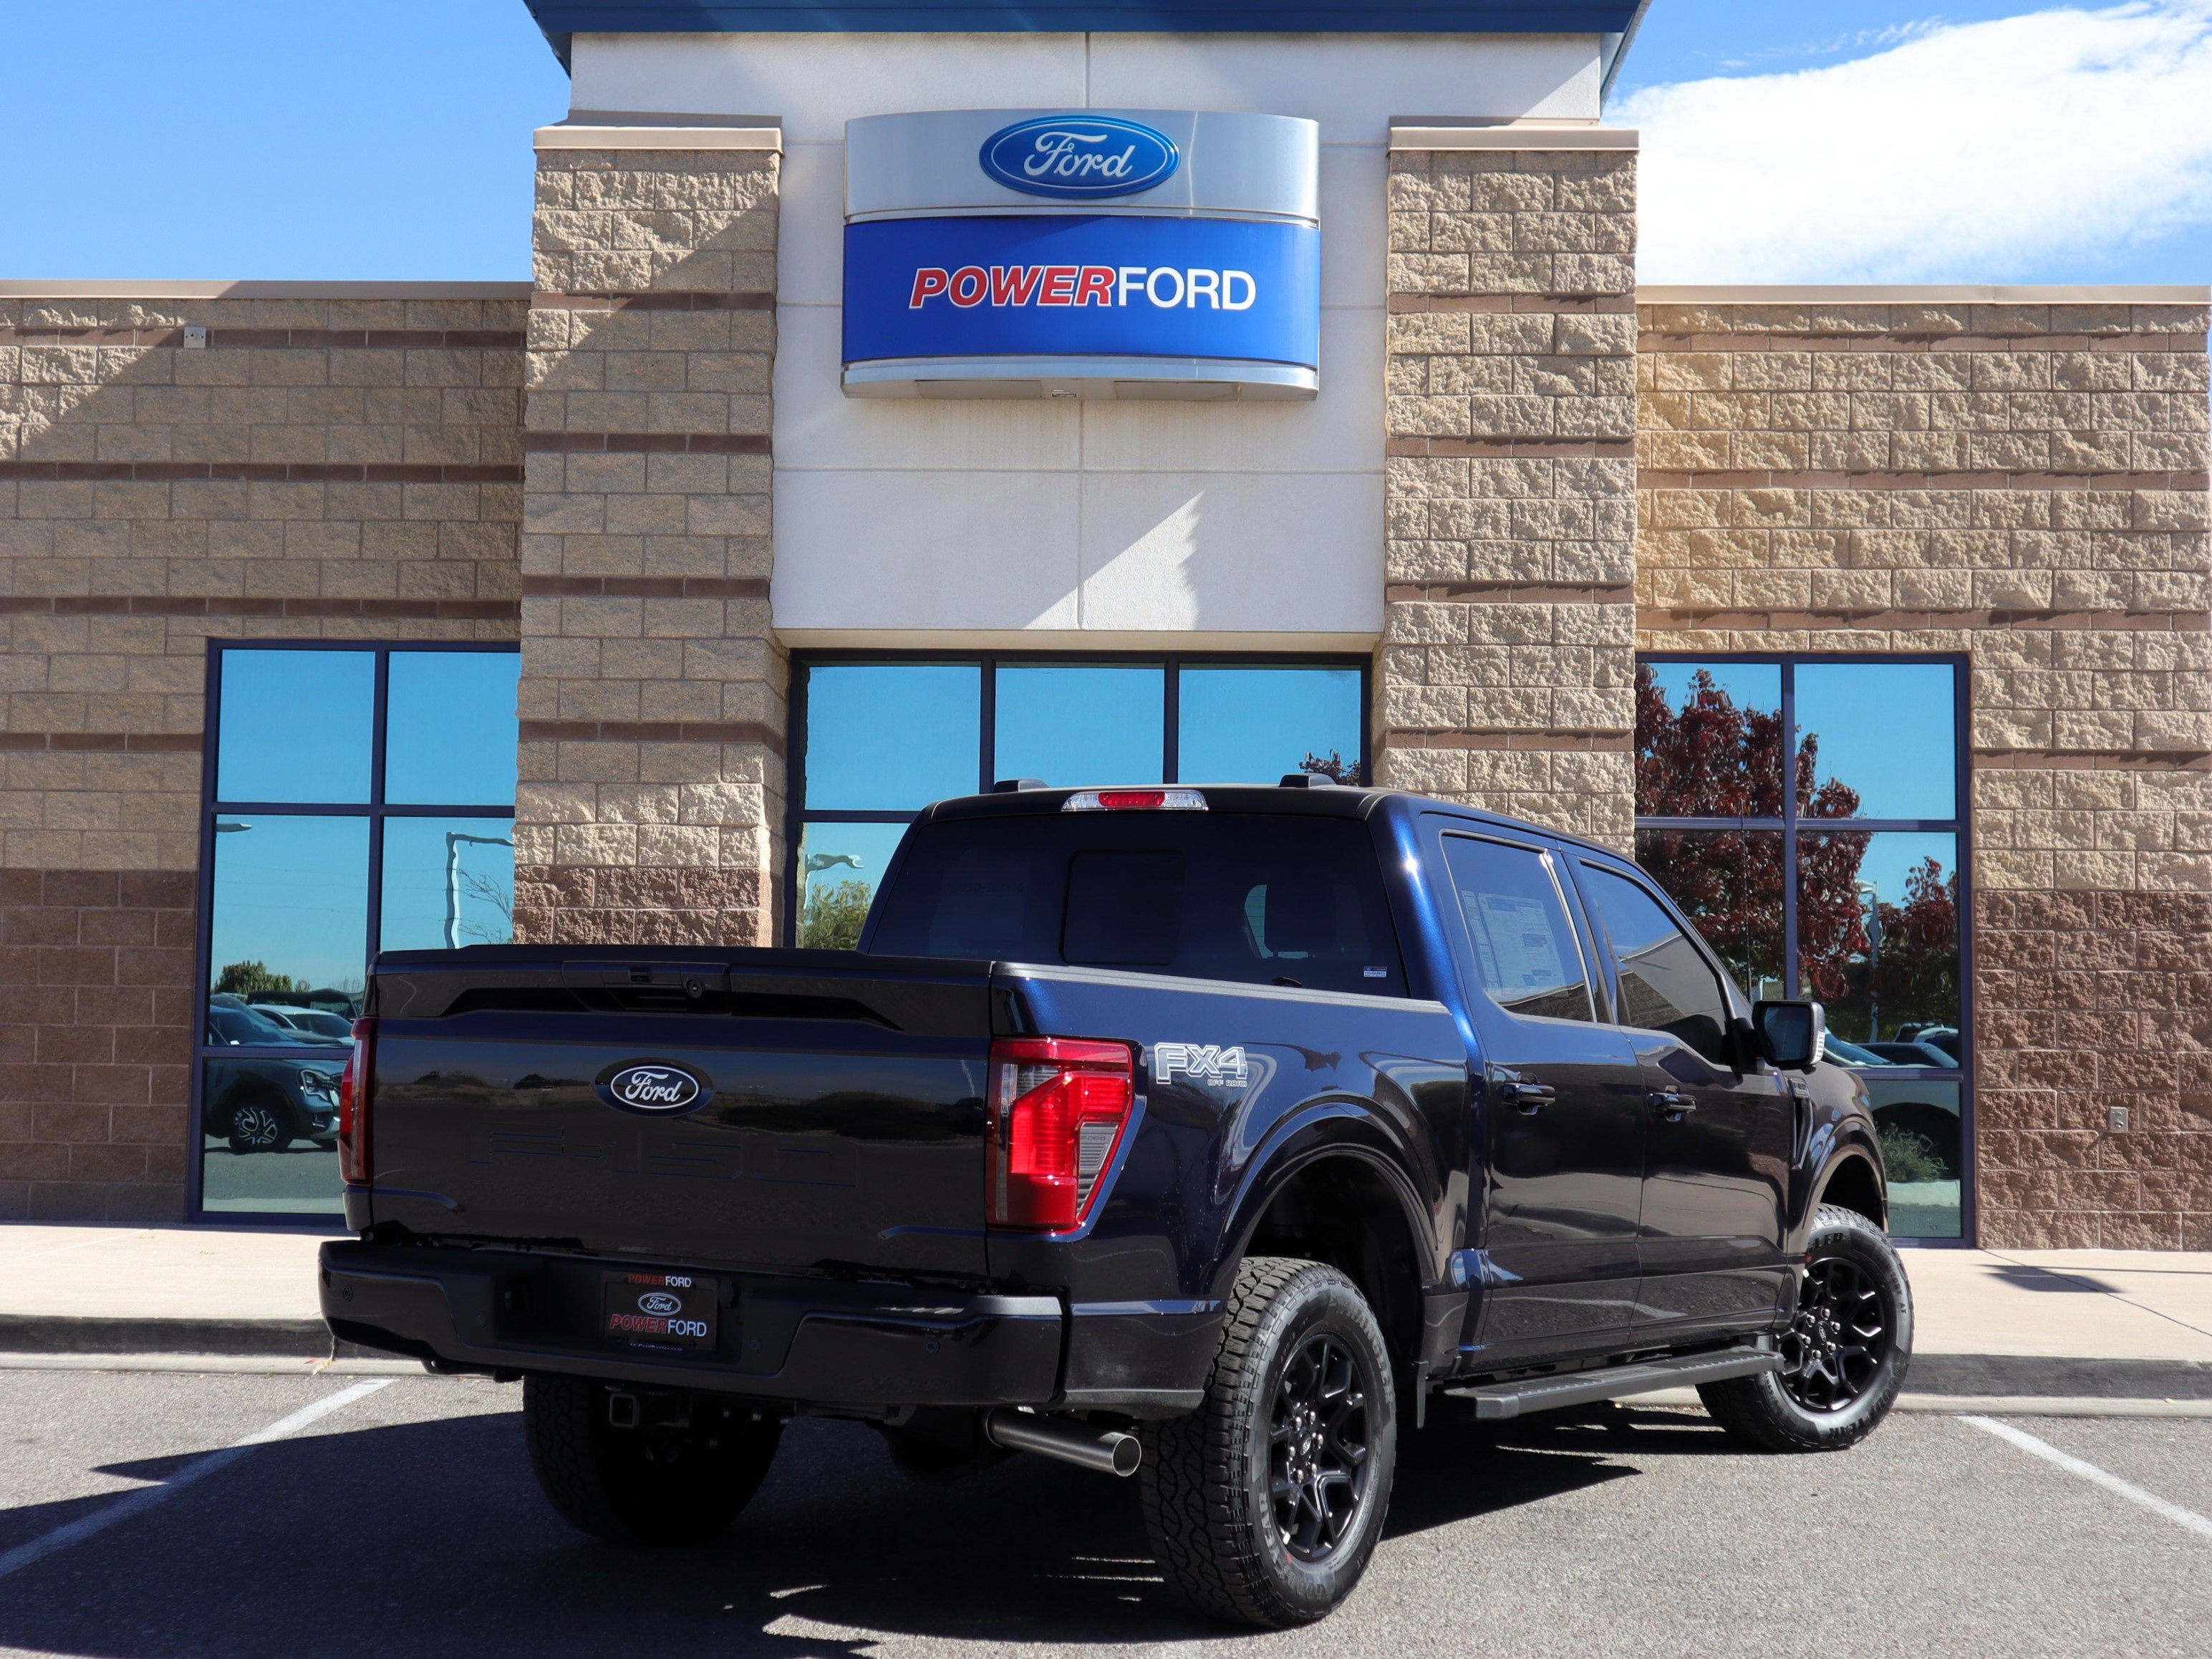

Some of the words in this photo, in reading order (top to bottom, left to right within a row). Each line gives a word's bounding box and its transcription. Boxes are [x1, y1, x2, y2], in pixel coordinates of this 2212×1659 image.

[1023, 131, 1136, 178] Ford
[908, 265, 1256, 310] POWERFORD
[1154, 1043, 1248, 1084] FX4
[625, 1071, 682, 1102] Ford
[647, 1297, 672, 1312] Ford
[610, 1315, 707, 1337] POWERFORD
